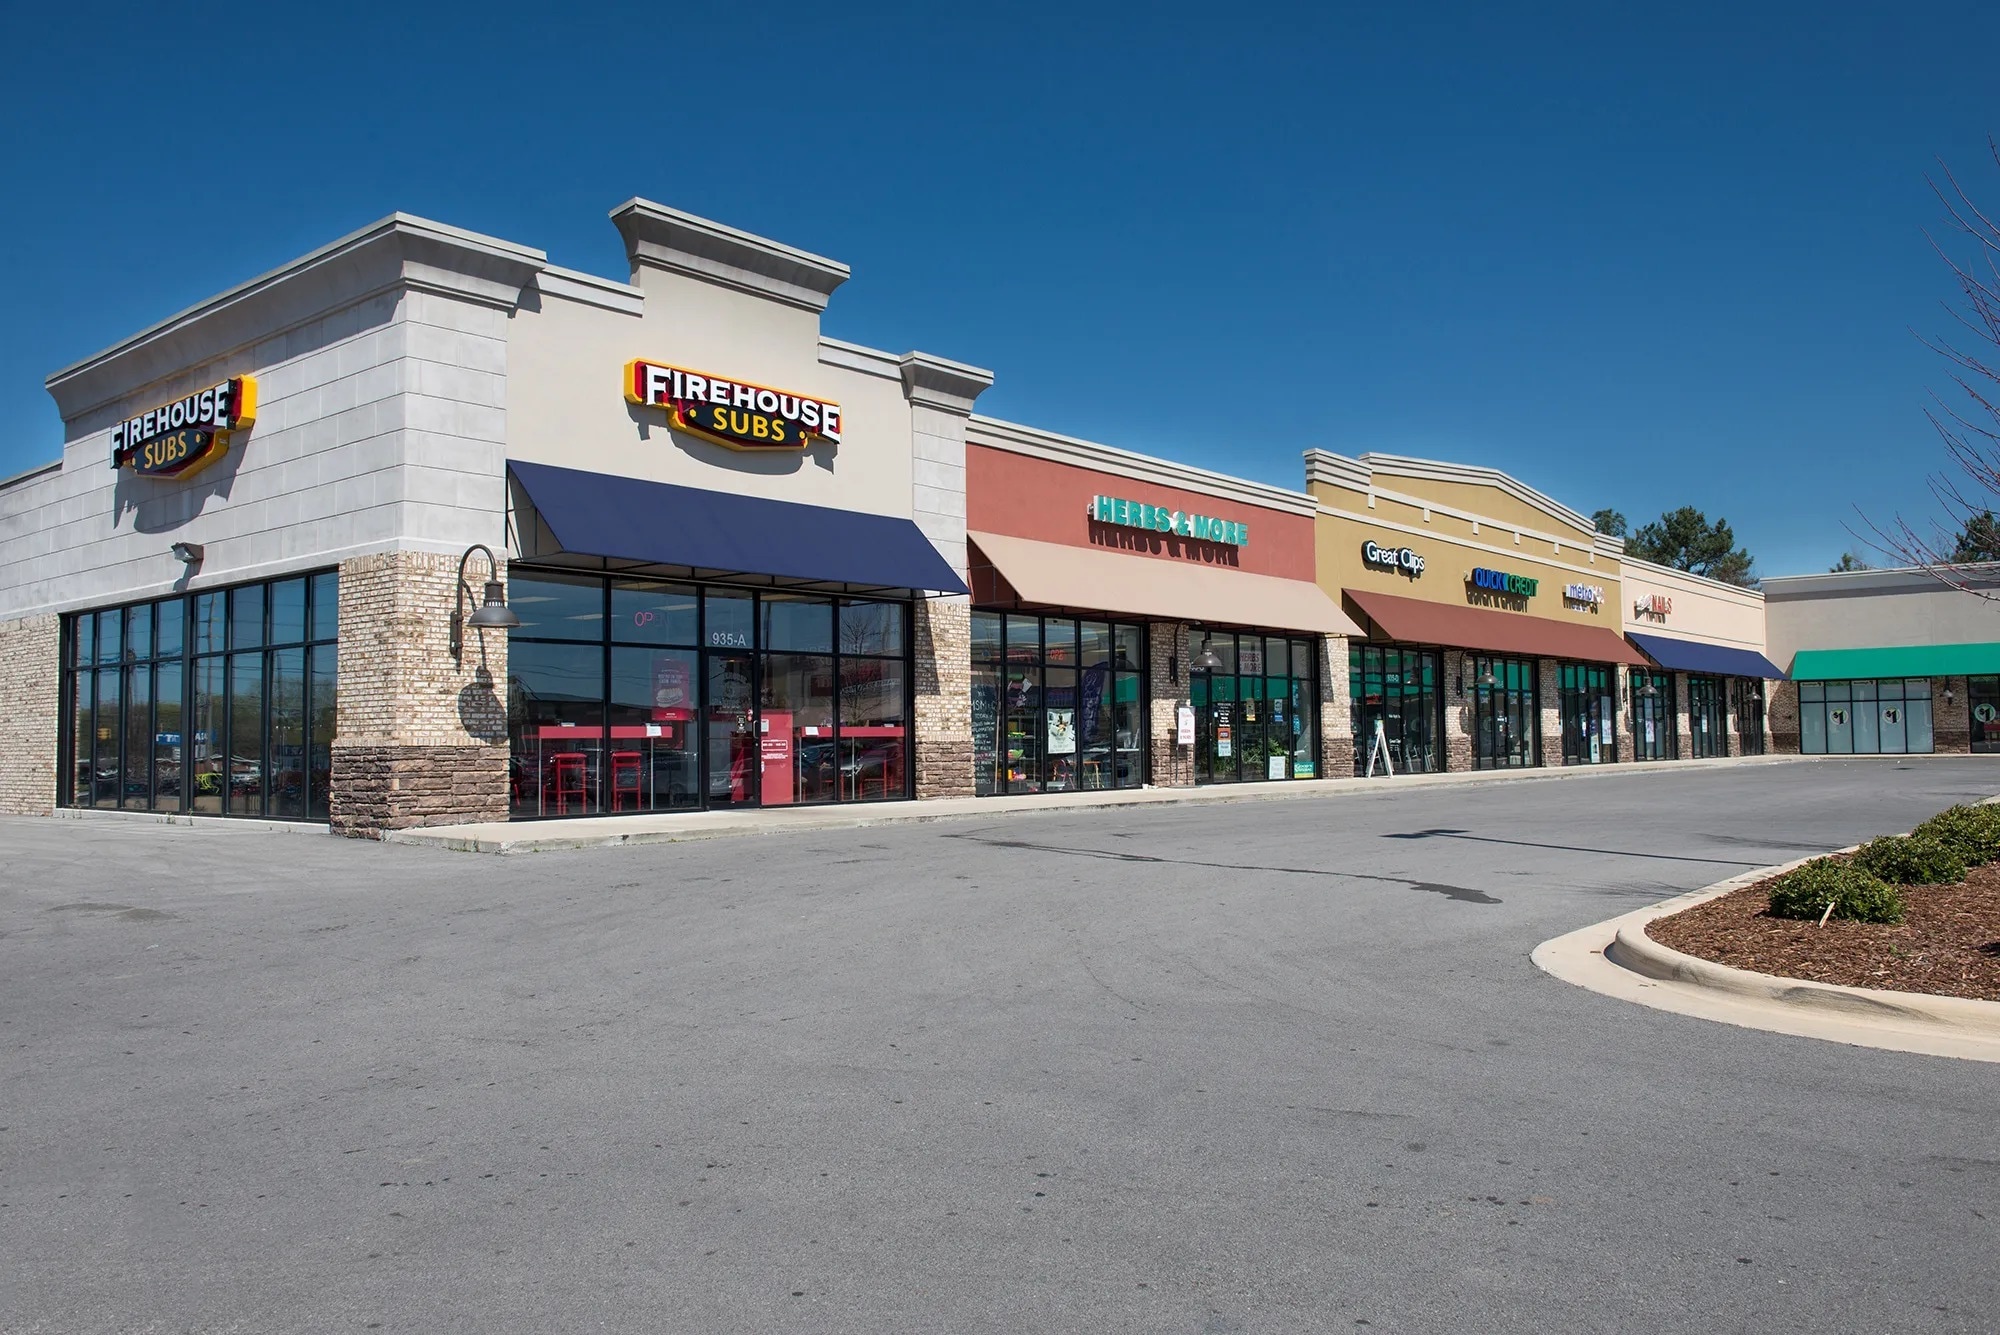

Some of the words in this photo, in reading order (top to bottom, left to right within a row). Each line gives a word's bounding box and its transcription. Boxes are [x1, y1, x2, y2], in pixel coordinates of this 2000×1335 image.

[646, 364, 840, 444] FIREHOUSE
[110, 381, 230, 469] FIREHOUSE
[713, 407, 785, 441] SUBS
[144, 431, 187, 469] SUBS
[1094, 494, 1171, 532] HERBS
[1173, 510, 1190, 536] &
[1190, 514, 1248, 546] MORE
[1366, 541, 1398, 565] Great
[1400, 548, 1425, 573] Clips
[1473, 567, 1505, 591] QUICK
[1508, 574, 1539, 597] CREDIT
[1651, 594, 1673, 614] NAILS
[712, 632, 746, 646] 935-A
[1240, 652, 1260, 662] HERBS
